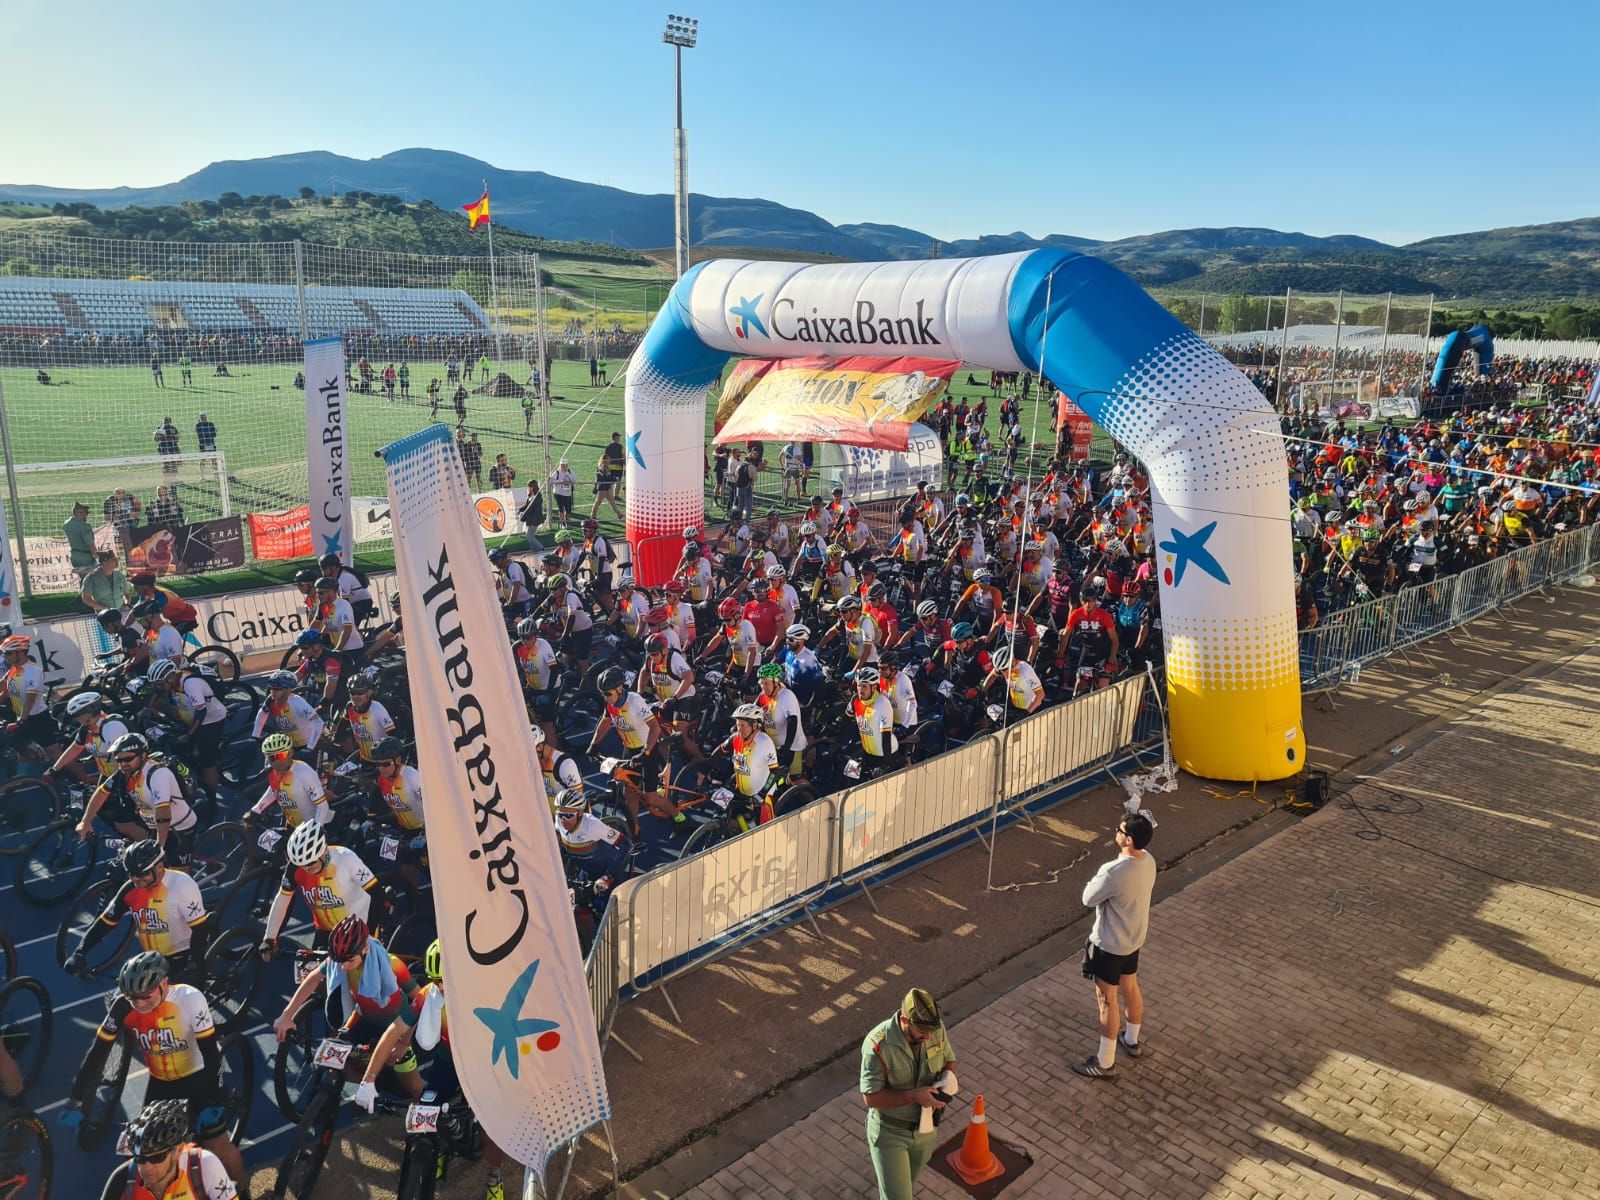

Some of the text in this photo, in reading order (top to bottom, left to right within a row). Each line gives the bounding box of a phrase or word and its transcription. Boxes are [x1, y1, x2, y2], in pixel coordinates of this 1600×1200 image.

[771, 298, 941, 345] CaixaBank
[318, 375, 342, 523] CaixaBank
[285, 520, 311, 534] MAP
[207, 610, 305, 643] Caixa
[423, 542, 530, 966] CaixaBank
